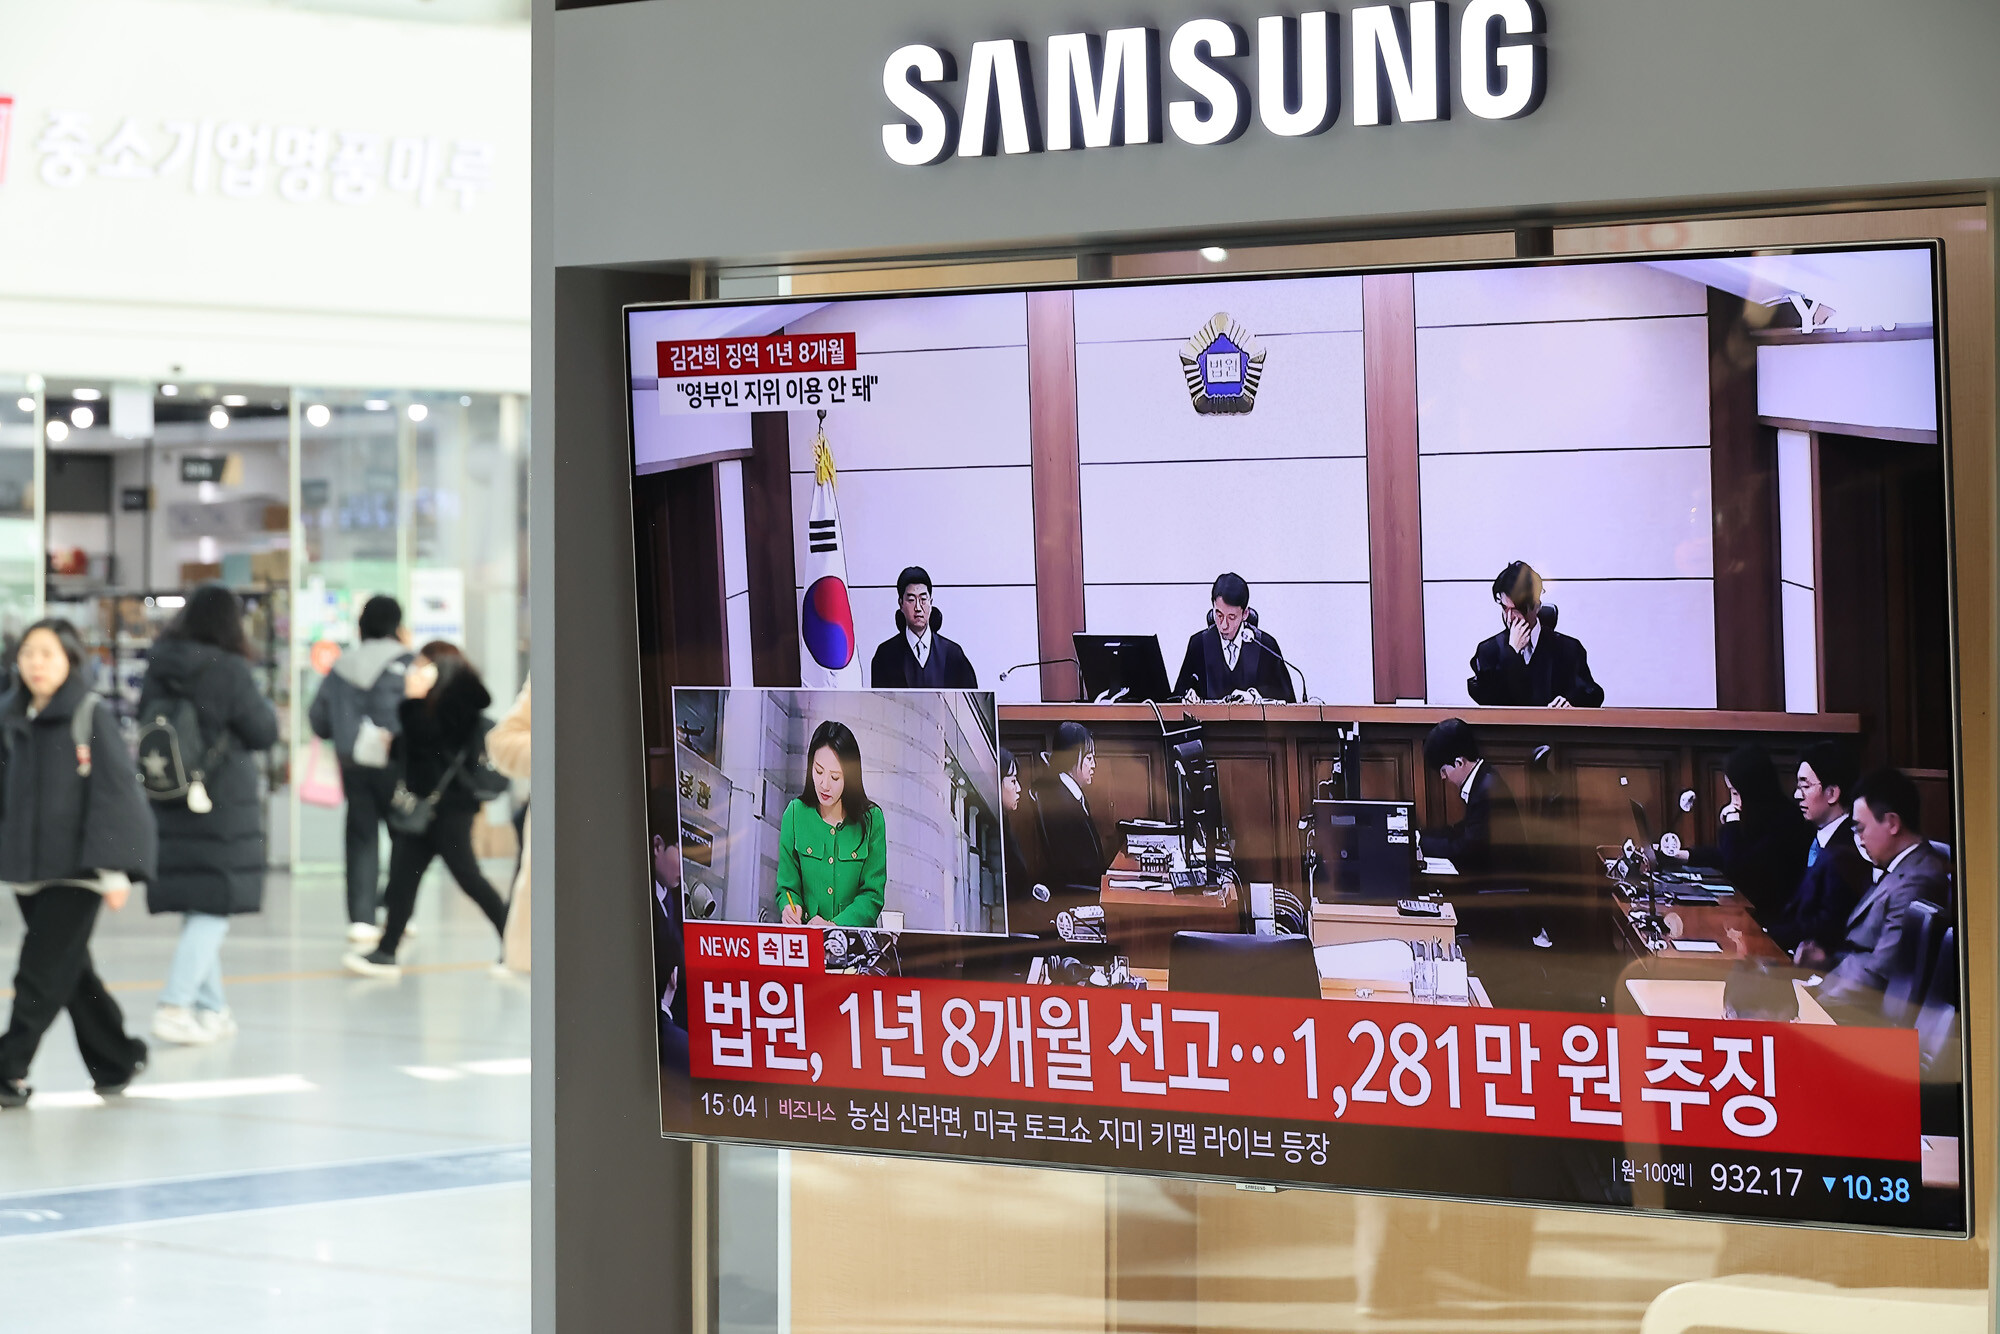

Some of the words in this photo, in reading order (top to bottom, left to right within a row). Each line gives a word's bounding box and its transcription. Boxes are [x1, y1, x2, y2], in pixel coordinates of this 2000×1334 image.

[881, 0, 1545, 166] SAMSUNG
[670, 343, 720, 371] 김건희
[726, 342, 759, 370] 징역
[766, 340, 793, 367] 1년
[798, 338, 845, 366] 8개월
[676, 379, 738, 409] "영부인
[744, 378, 780, 406] 지위
[786, 377, 823, 405] 이용
[828, 375, 847, 403] 안
[852, 374, 879, 402] 돼"
[699, 935, 751, 958] NEWS
[762, 937, 805, 961] 속보
[703, 980, 823, 1083] 법원,
[838, 989, 926, 1079] 1년
[941, 996, 1094, 1092] 8개월
[1557, 1024, 1622, 1126] 원
[1640, 1029, 1780, 1138] 추징
[700, 1092, 757, 1118] 15:04
[778, 1098, 837, 1123] 비즈니스
[847, 1099, 890, 1132] 농심
[896, 1103, 968, 1139] 신라면,
[973, 1108, 1018, 1142] 미국
[1023, 1113, 1093, 1144] 토크쇼
[1098, 1117, 1143, 1151] 지미
[1150, 1120, 1198, 1156] 키멜
[1203, 1125, 1276, 1159] 라이브
[1280, 1130, 1331, 1166] 등장
[1709, 1162, 1803, 1197] 932.17
[1842, 1174, 1911, 1203] 10.38
